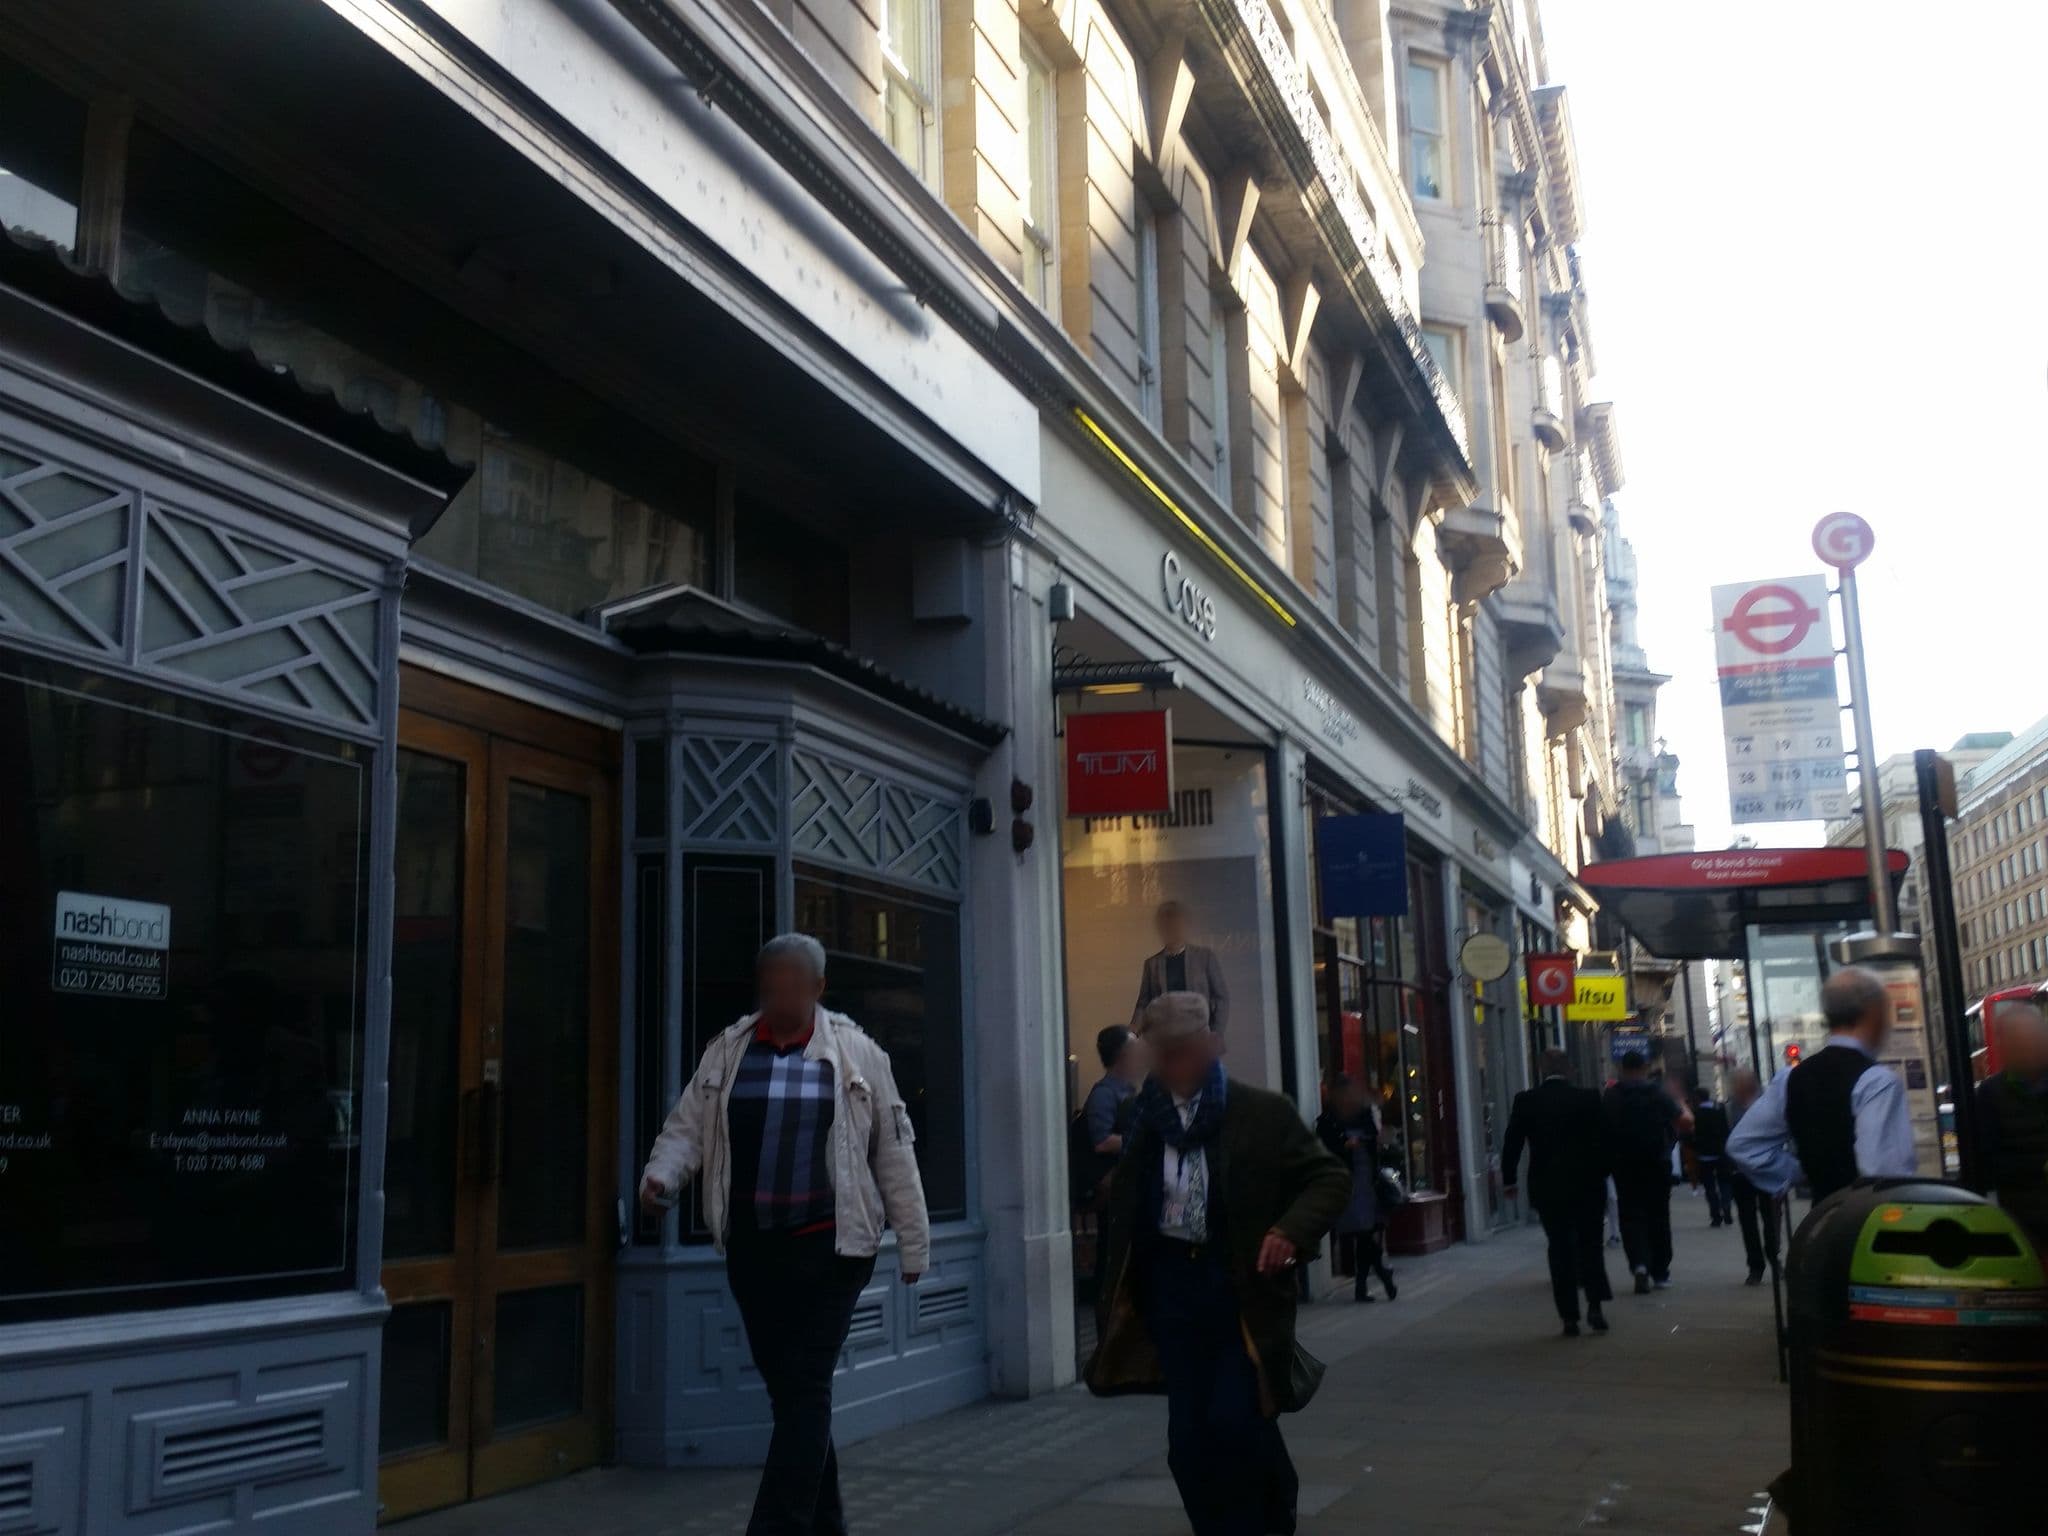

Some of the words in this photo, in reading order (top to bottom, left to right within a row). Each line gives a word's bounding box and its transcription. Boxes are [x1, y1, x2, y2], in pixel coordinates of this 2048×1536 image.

[1819, 517, 1862, 561] G
[1162, 550, 1217, 641] Case
[1076, 749, 1157, 776] TUMI
[1691, 858, 1713, 870] Old
[1715, 857, 1745, 869] Bond
[1746, 856, 1782, 867] Street
[63, 906, 164, 941] nashbond
[61, 943, 161, 968] nashbond.co.uk
[61, 967, 88, 989] 020
[90, 970, 125, 992] 7290
[127, 974, 160, 995] 4555
[1578, 986, 1615, 1005] itsu
[182, 1109, 221, 1126] ANNA
